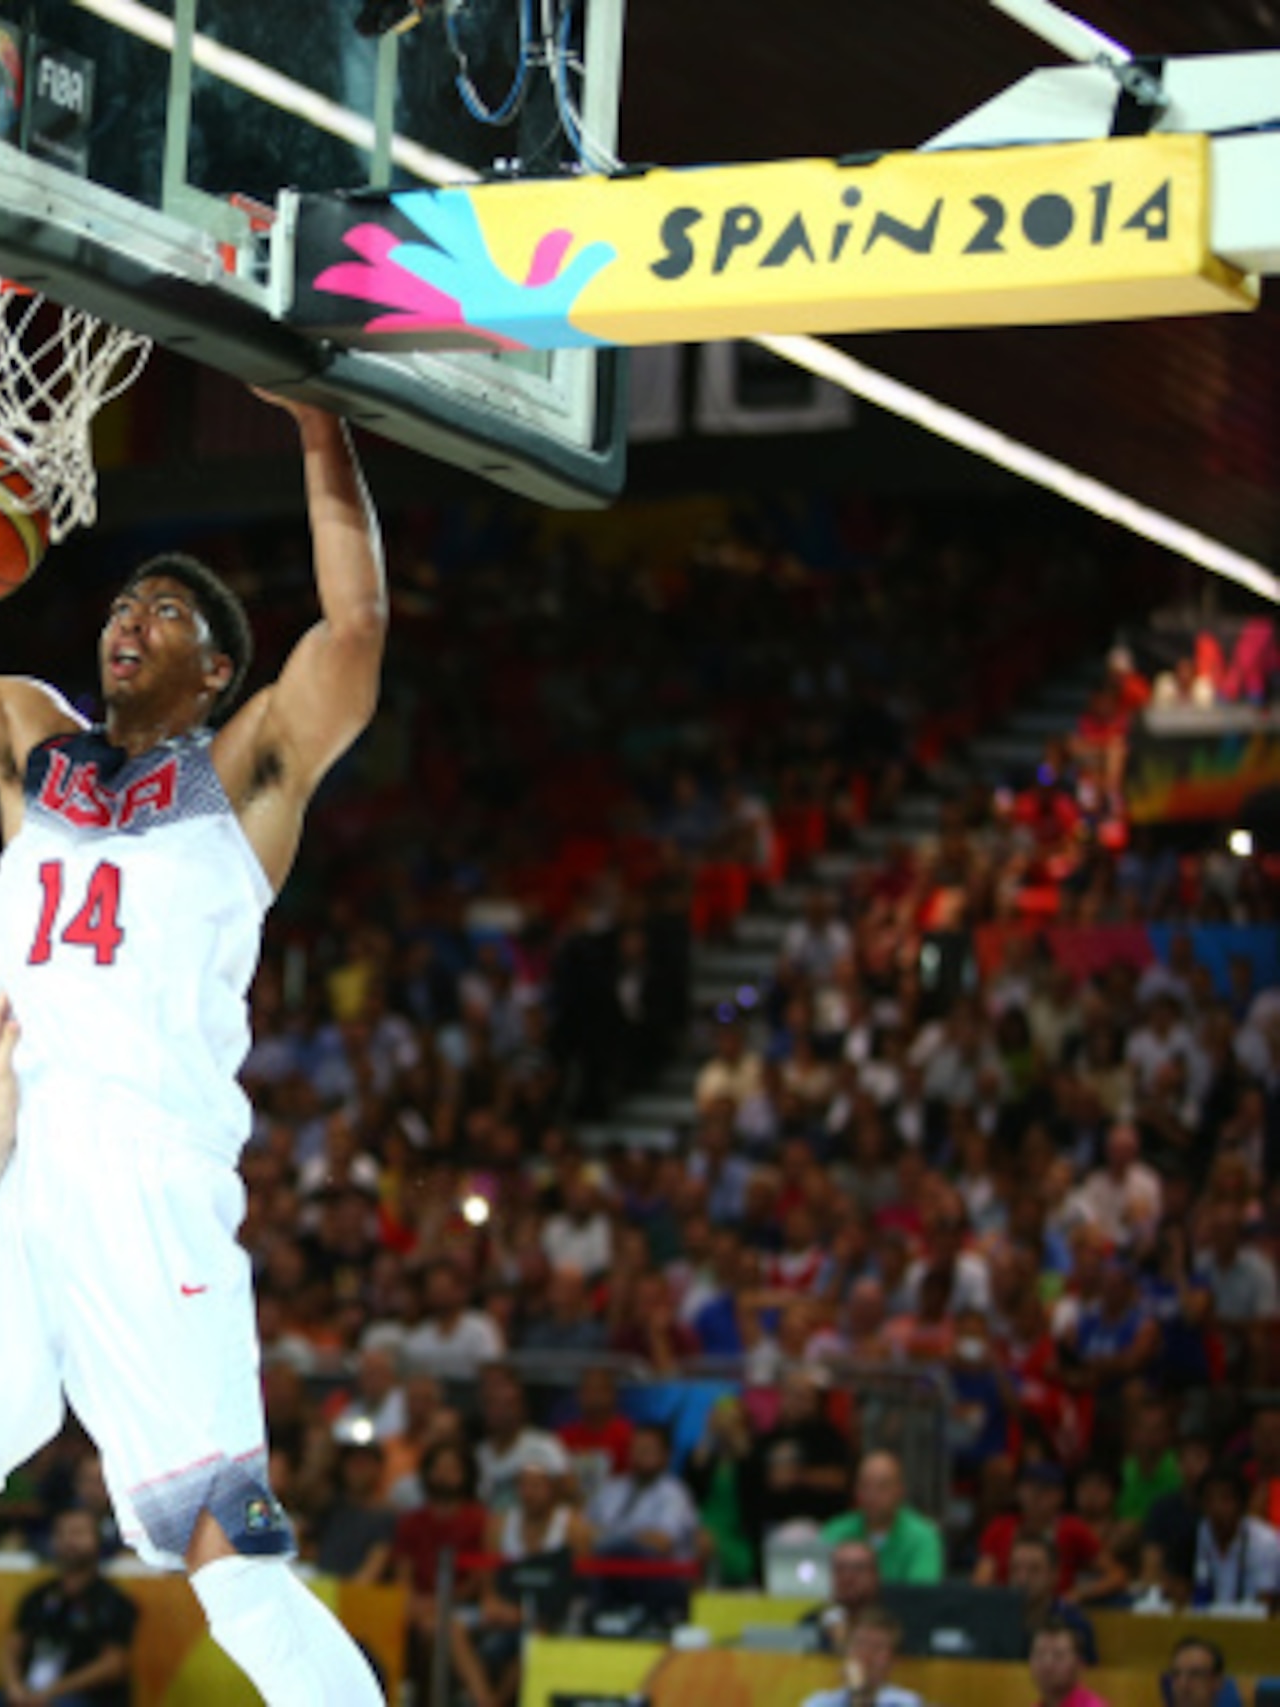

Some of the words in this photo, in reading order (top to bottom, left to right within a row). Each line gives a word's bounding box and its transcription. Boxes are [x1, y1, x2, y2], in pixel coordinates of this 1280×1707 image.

[38, 57, 84, 113] FIBA
[38, 750, 181, 830] USA
[27, 859, 124, 966] 14
